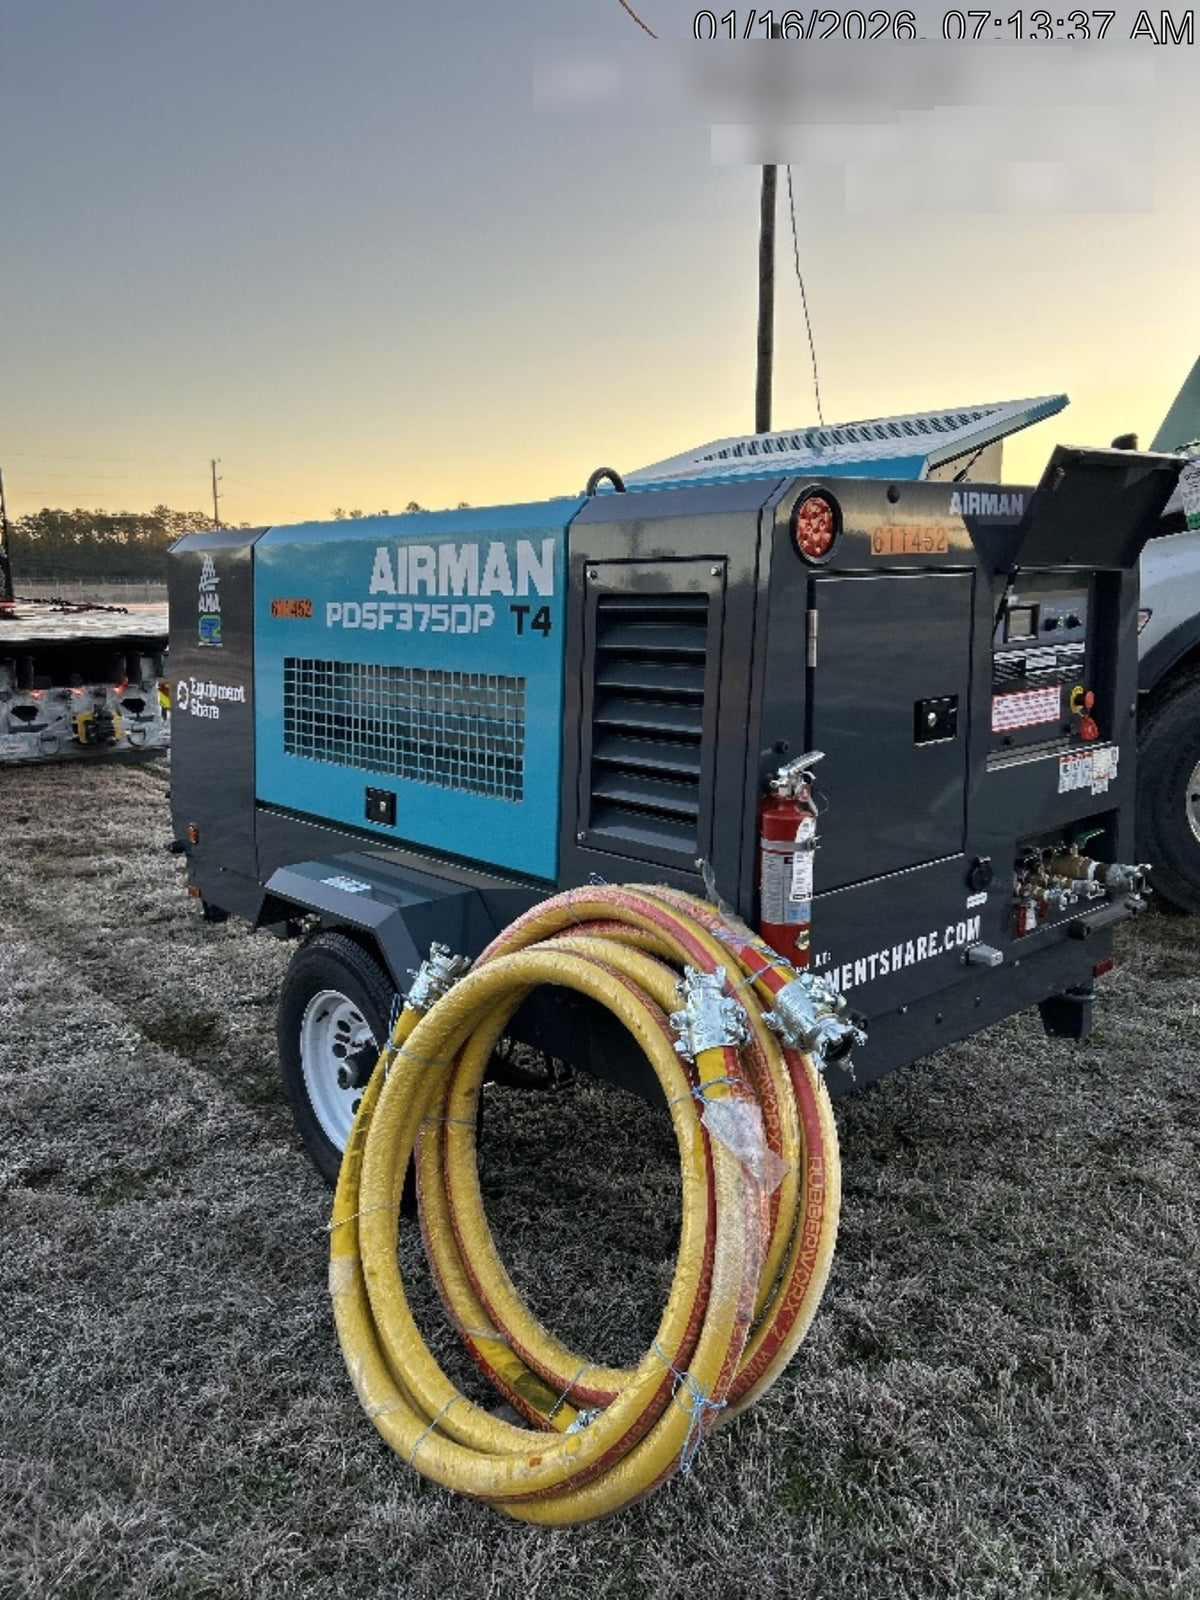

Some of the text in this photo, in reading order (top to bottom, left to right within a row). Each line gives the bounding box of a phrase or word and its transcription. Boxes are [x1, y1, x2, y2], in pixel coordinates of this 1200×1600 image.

[949, 491, 1024, 516] AIRMAN
[369, 538, 555, 597] AIRMAN
[326, 602, 552, 637] PDSF375DP T4
[190, 677, 246, 703] Equipment
[190, 698, 219, 719] Share
[824, 915, 981, 994] MENTSHARE.COM
[781, 1156, 824, 1317] RUBBERWORX
